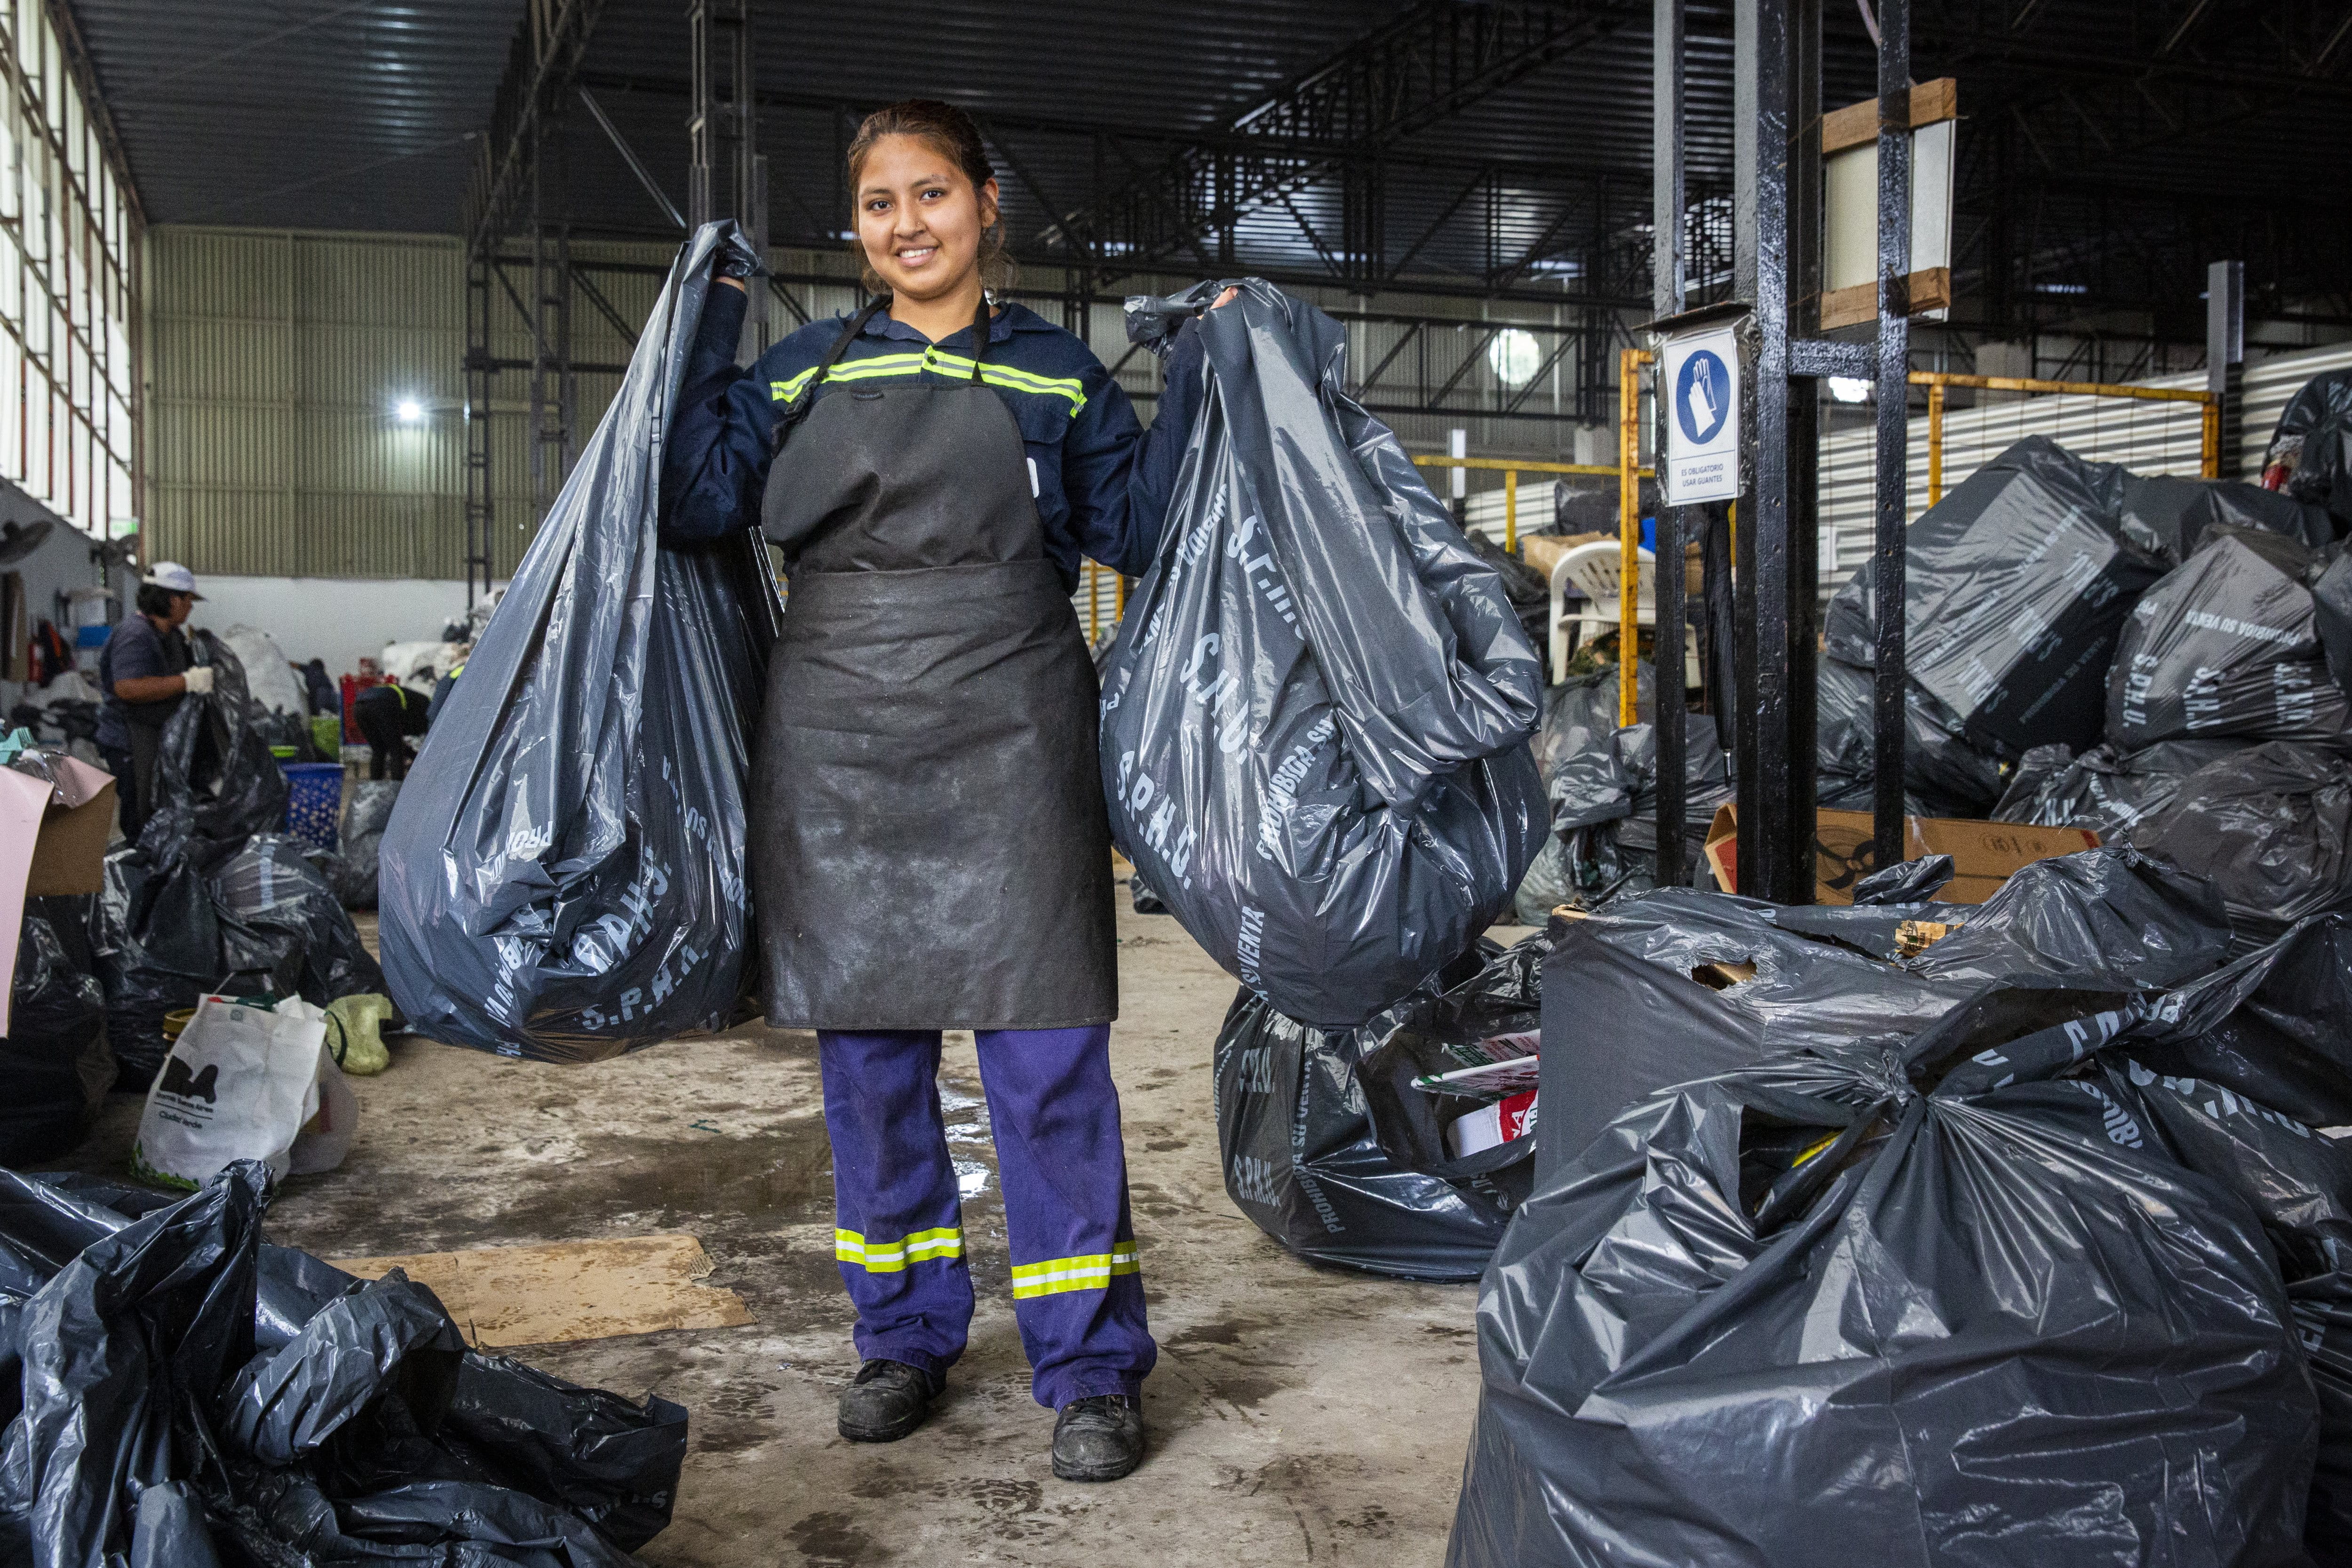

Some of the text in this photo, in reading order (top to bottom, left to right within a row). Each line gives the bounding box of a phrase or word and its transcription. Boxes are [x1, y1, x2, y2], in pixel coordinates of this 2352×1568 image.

[1682, 474, 1723, 487] USAR GUANTES
[1688, 463, 1724, 475] OBLIGATORIO
[2122, 653, 2158, 728] S.P.H.U.
[1256, 745, 1316, 860] PROHIBIDA
[1237, 906, 1264, 971] VENTA
[1292, 1123, 1307, 1147] SU
